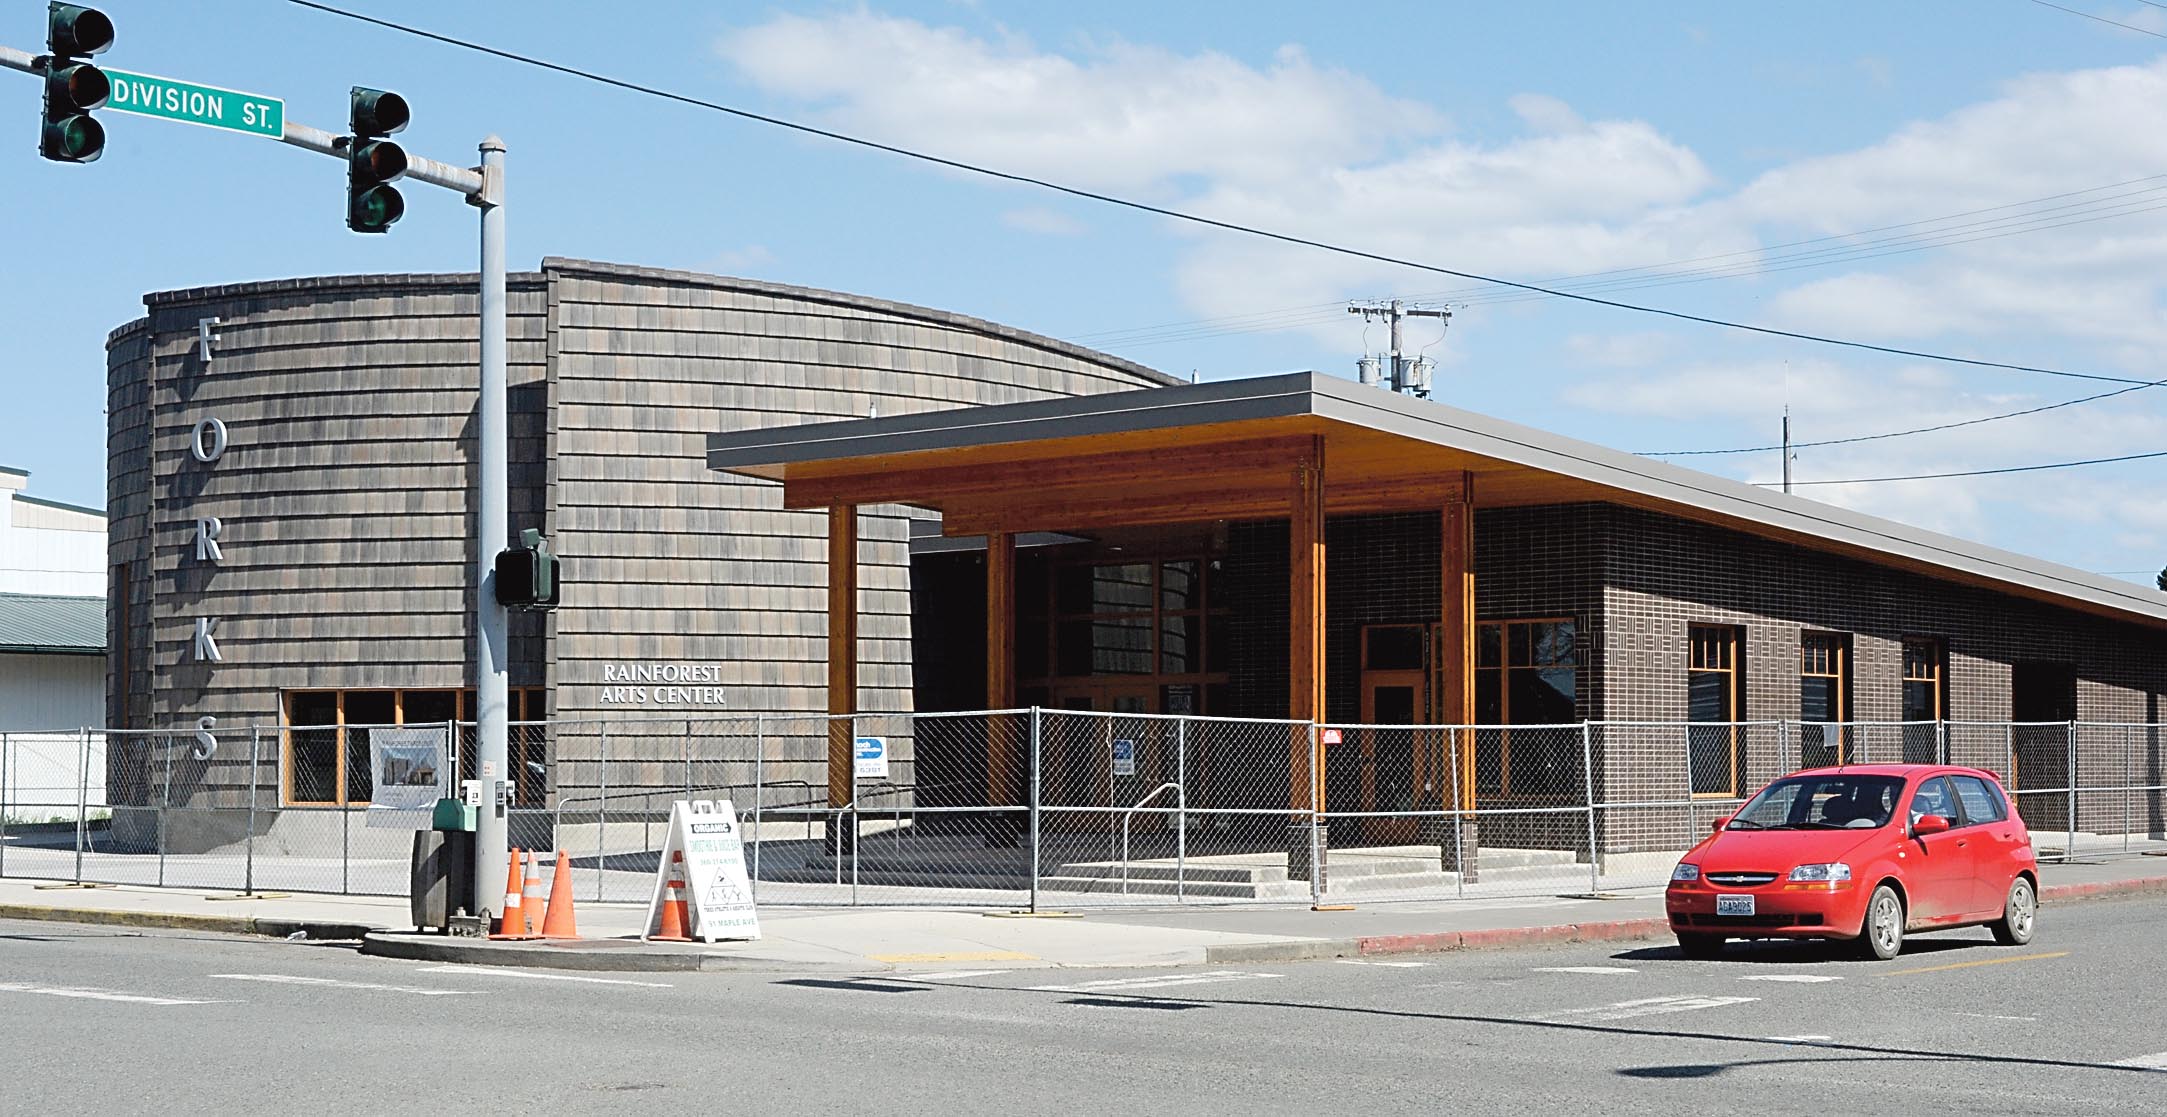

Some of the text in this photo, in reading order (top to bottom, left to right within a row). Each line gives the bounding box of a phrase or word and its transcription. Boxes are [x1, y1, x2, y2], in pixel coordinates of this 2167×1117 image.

[113, 78, 273, 130] DIVISION ST.
[604, 664, 722, 683] RAINFOREST
[599, 686, 726, 705] ARTS CENTER
[693, 823, 729, 834] ORGANIC
